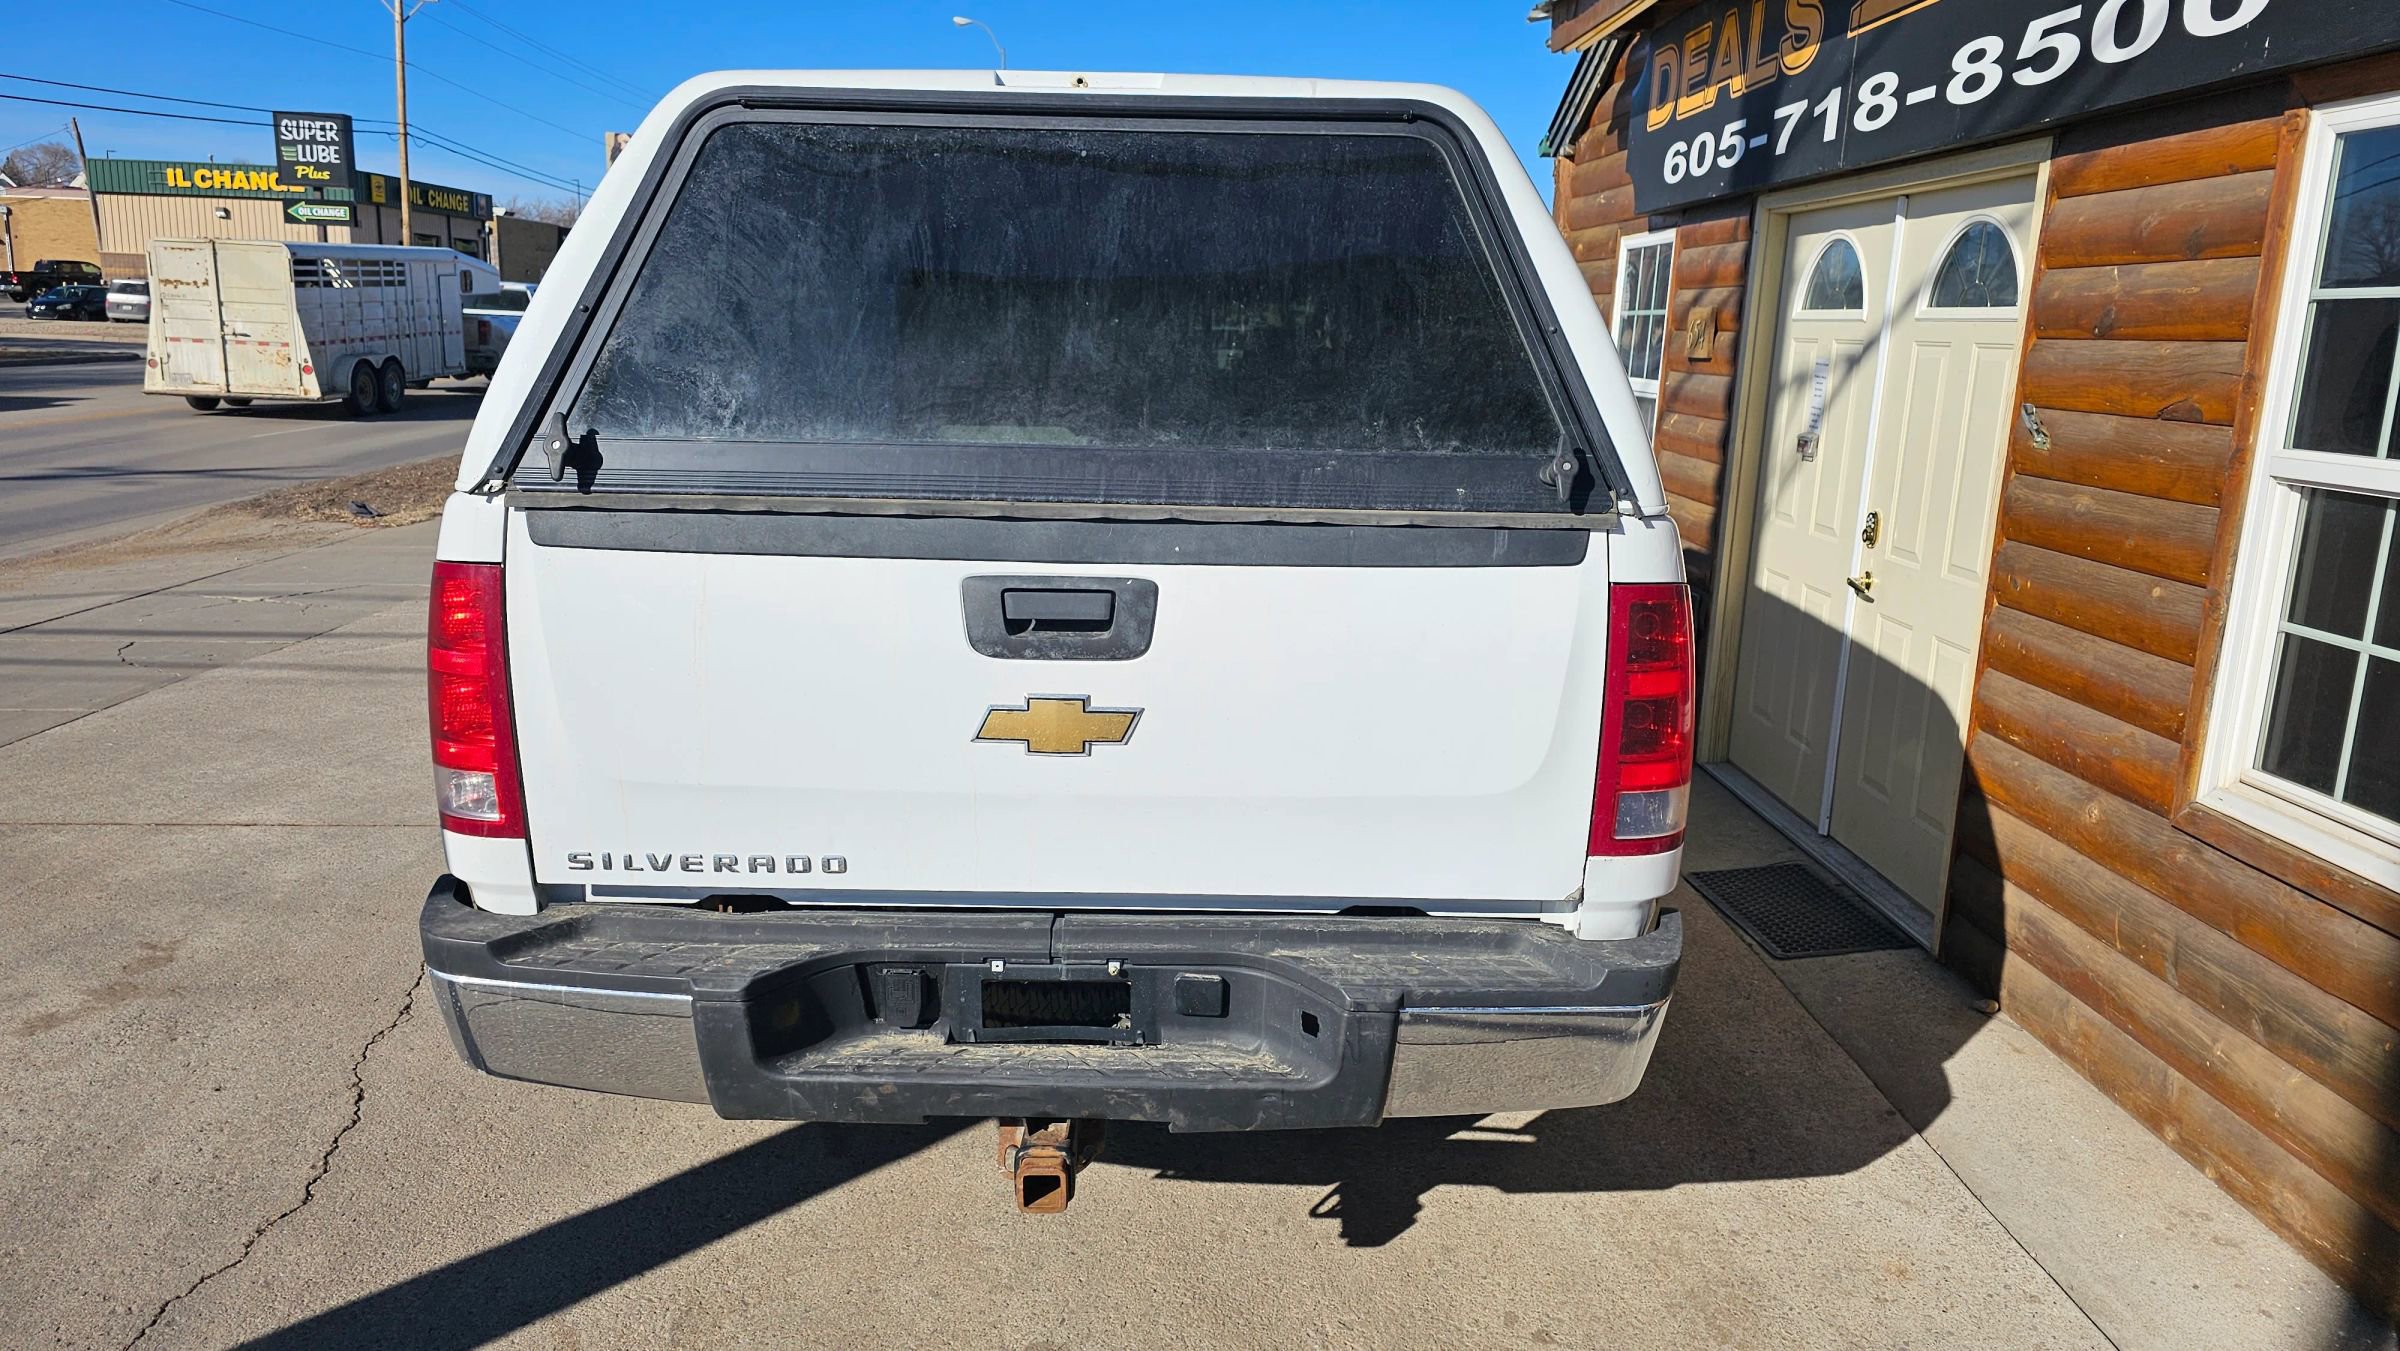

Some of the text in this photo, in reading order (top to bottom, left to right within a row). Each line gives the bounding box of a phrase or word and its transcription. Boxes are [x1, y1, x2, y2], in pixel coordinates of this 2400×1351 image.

[1646, 0, 1825, 132] DEALS
[280, 119, 340, 142] SUPER
[297, 145, 342, 164] LUBE
[194, 168, 306, 193] CHANG
[294, 165, 331, 180] Plus
[297, 206, 346, 218] OIL CHANGE
[428, 189, 469, 212] CHANGE
[1687, 319, 1707, 352] 654
[567, 851, 849, 874] SILVERADO
